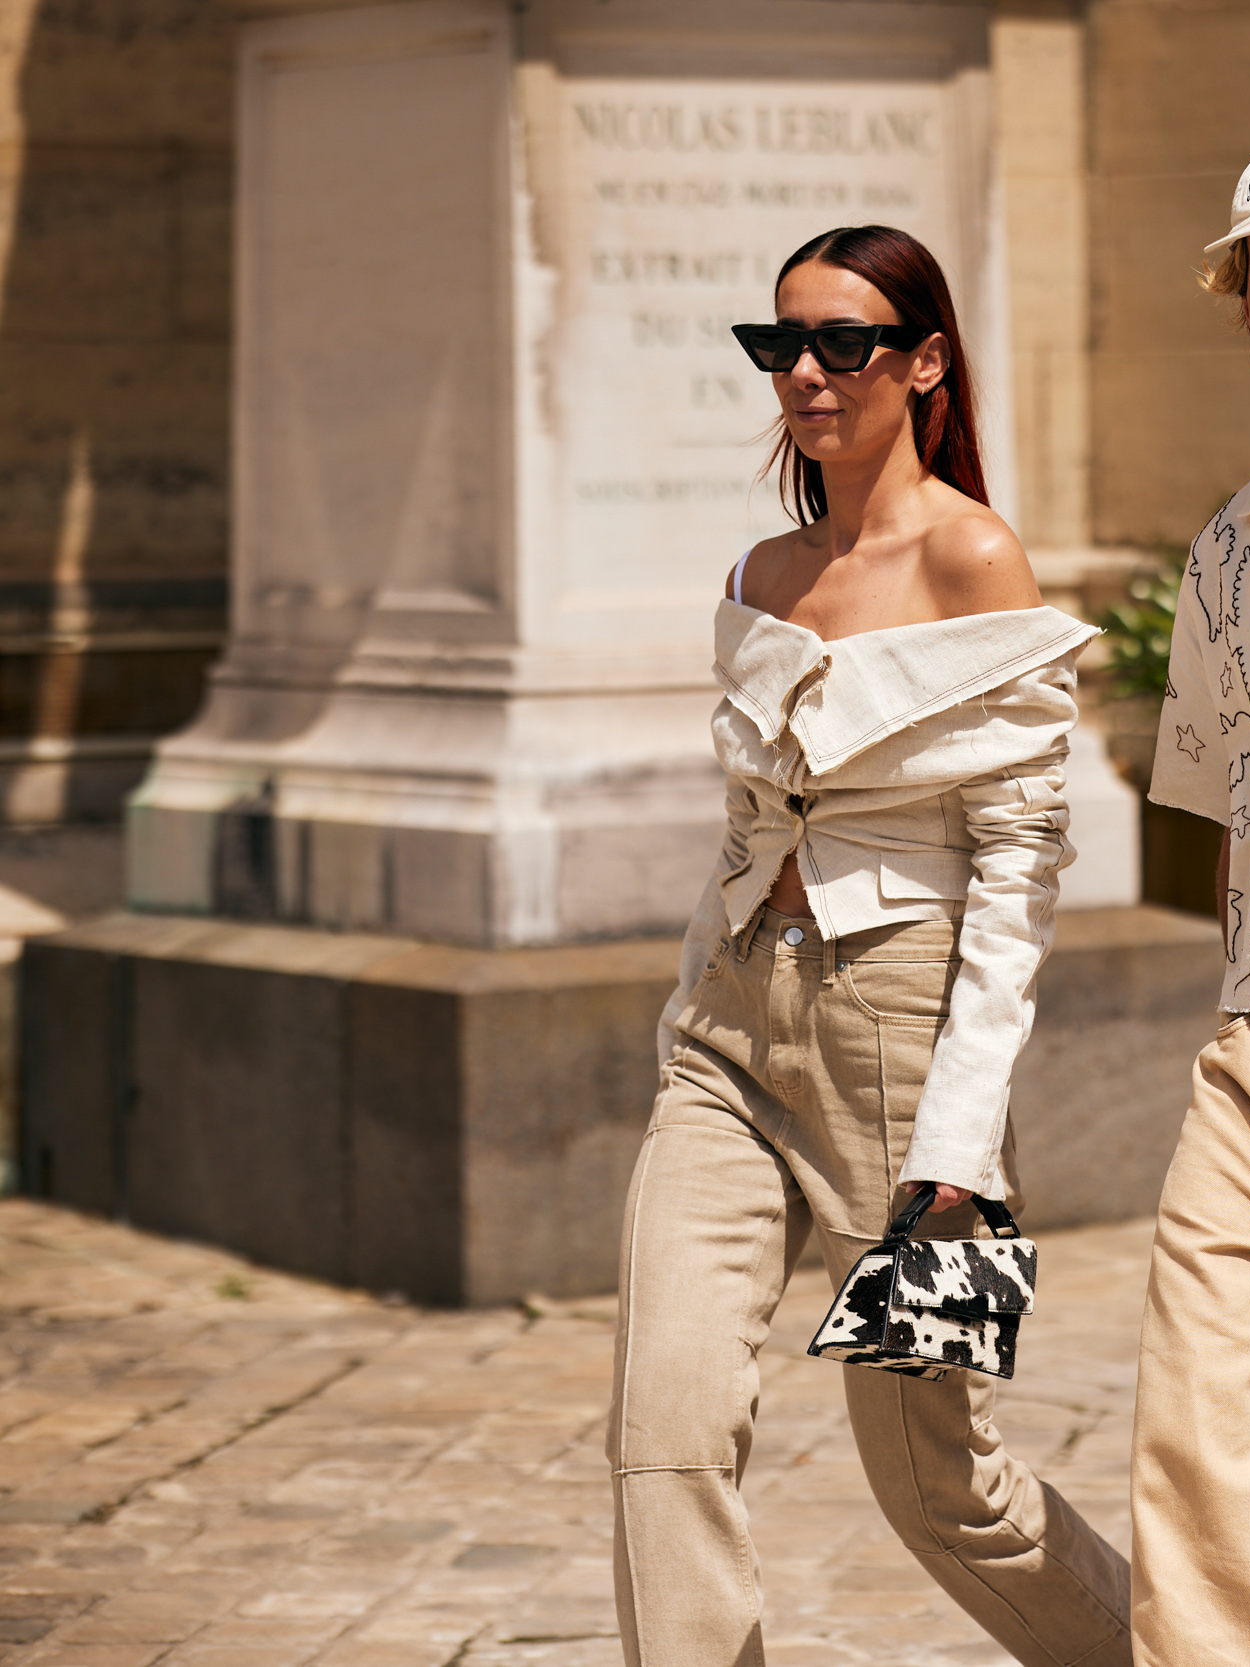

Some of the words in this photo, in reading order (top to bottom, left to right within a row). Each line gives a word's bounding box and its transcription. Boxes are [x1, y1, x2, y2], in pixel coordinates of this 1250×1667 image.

[574, 103, 742, 153] NICOLAS
[755, 103, 935, 156] LEBLANC
[593, 251, 744, 287] EXTRAIT
